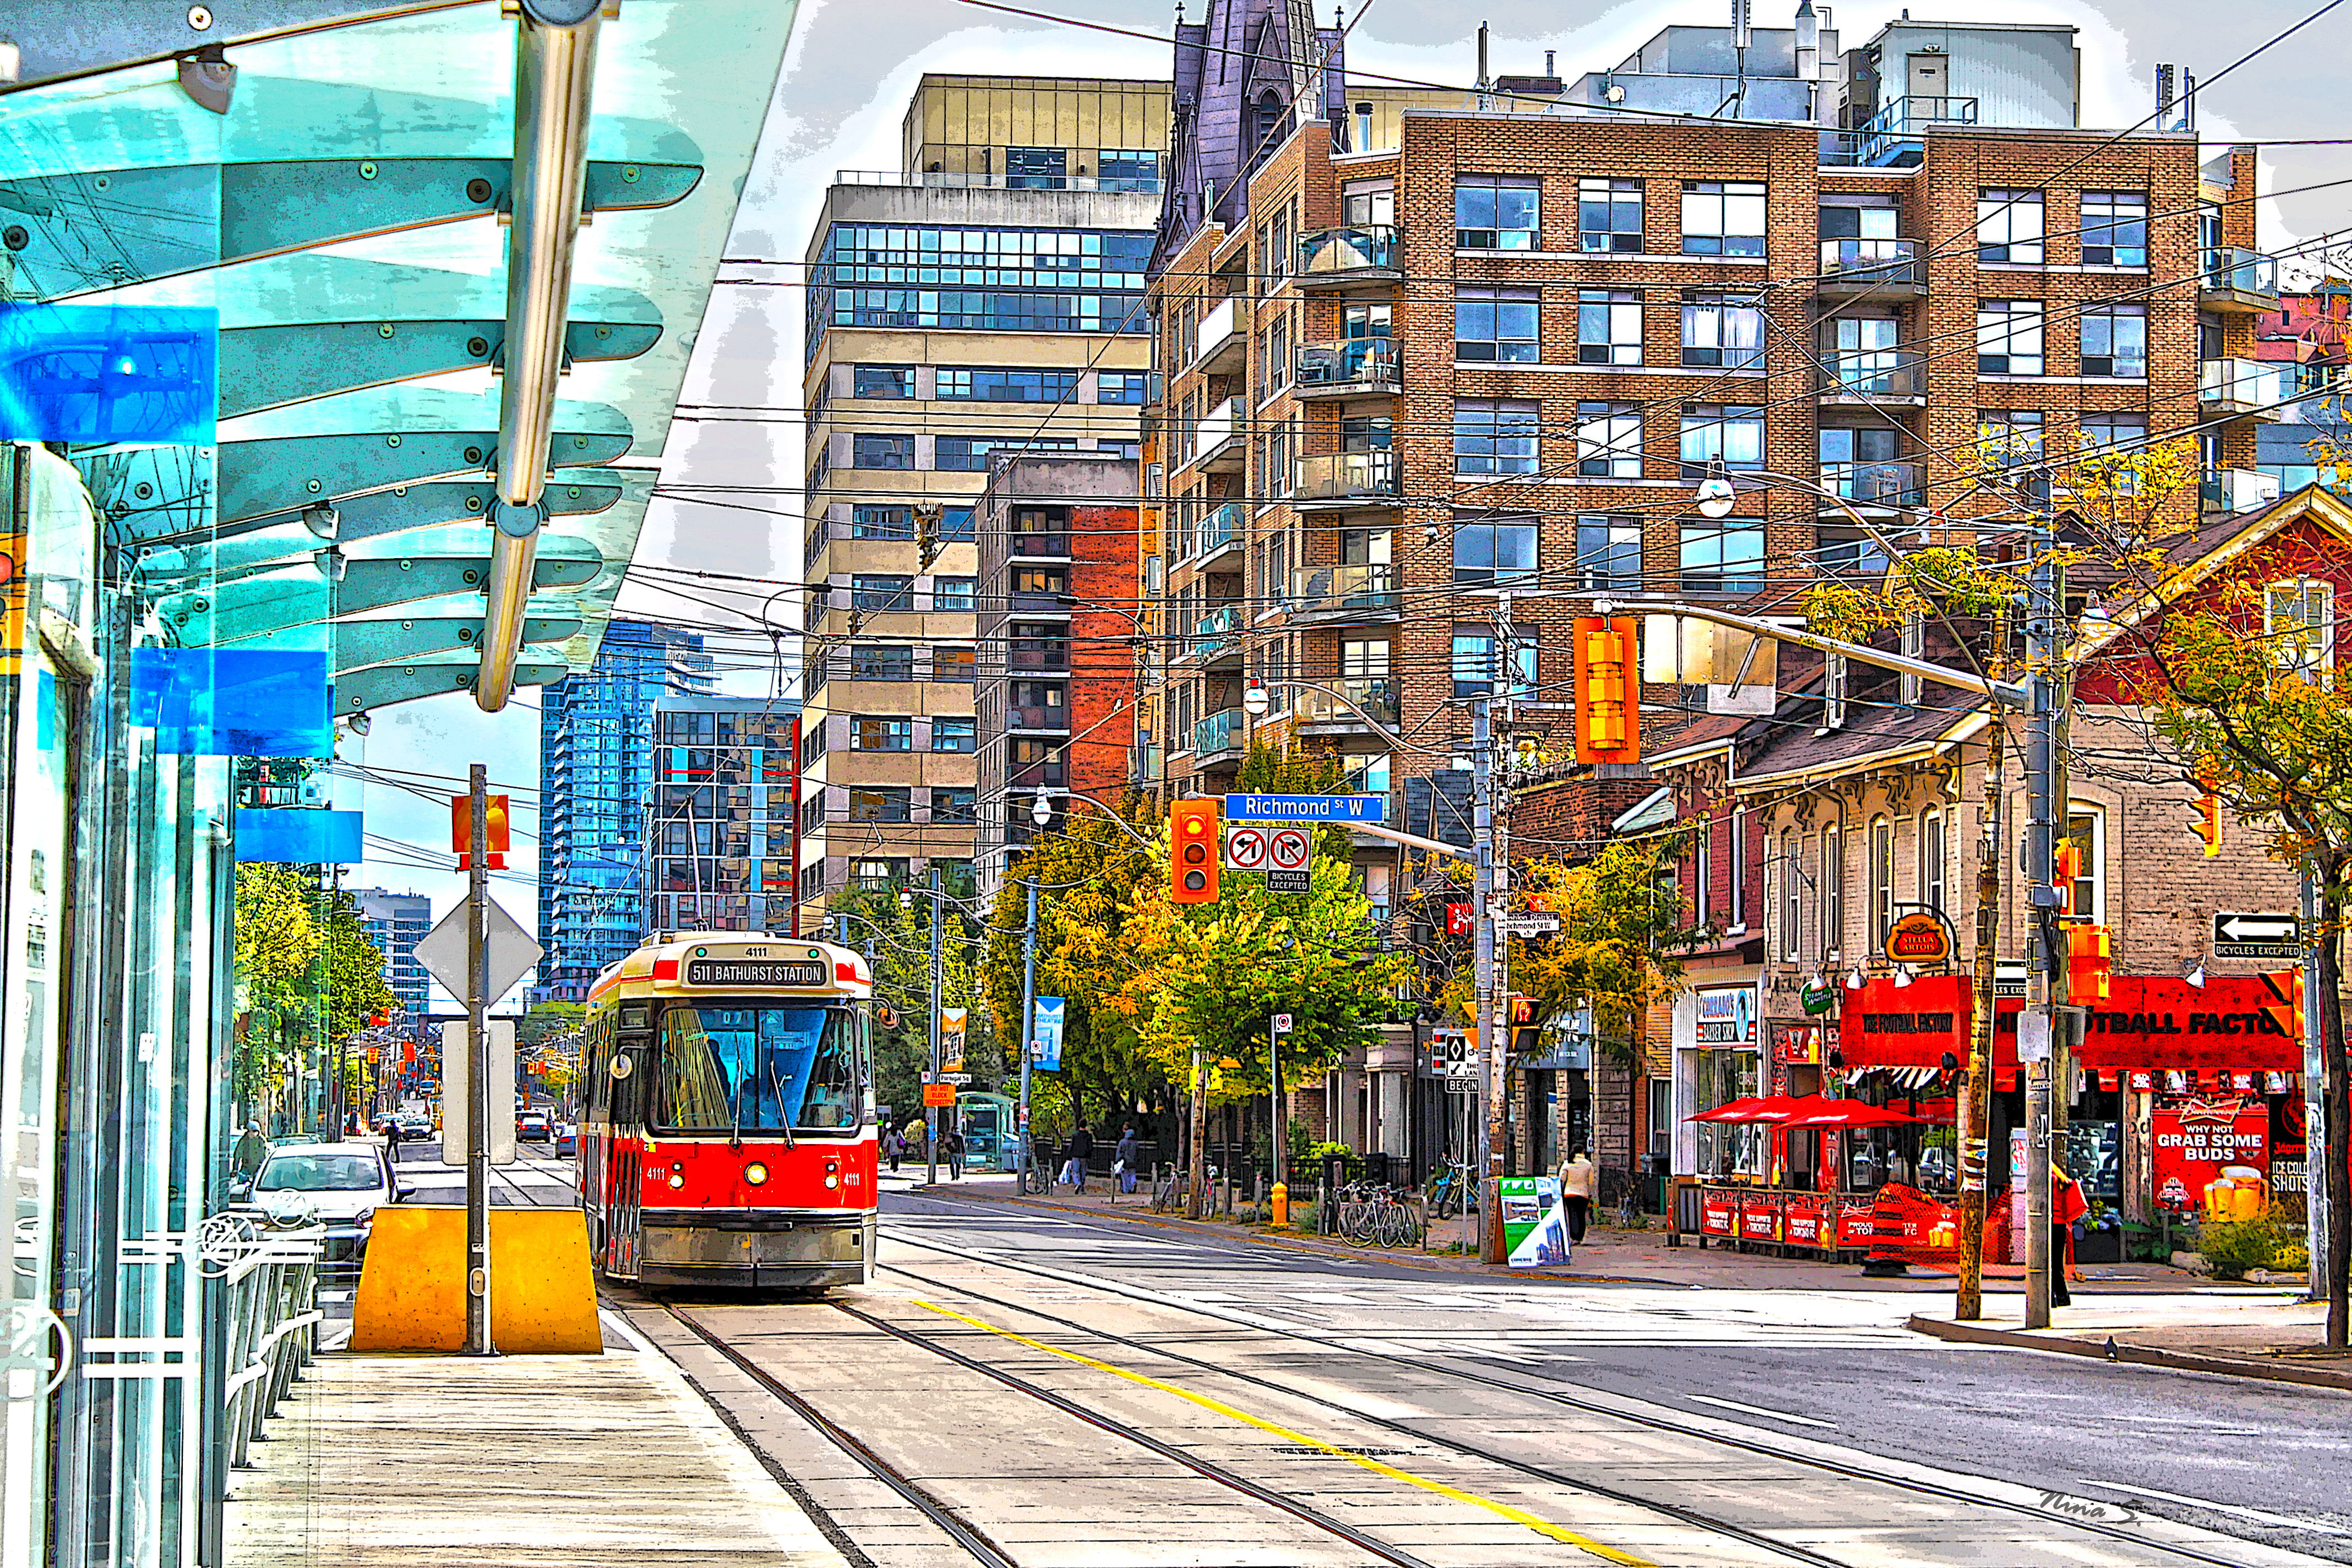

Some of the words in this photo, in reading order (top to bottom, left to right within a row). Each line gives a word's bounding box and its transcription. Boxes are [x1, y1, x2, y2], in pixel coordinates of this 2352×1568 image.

[1246, 798, 1330, 815] Richmond
[1335, 799, 1344, 809] St
[1349, 799, 1364, 816] W
[1271, 872, 1306, 881] BICYCLES
[1270, 881, 1308, 890] EXCEPTED
[745, 947, 767, 957] 4111
[2216, 946, 2255, 955] BICYCLES
[693, 965, 711, 981] 511
[715, 966, 772, 981] BATHURST
[775, 966, 821, 981] STATION
[1862, 1014, 1877, 1033] THE
[1878, 1014, 1917, 1033] FOOTBALL
[1918, 1012, 1953, 1032] FACTORY
[2189, 1012, 2275, 1034] FACTO
[2185, 1125, 2211, 1134] WHY
[2212, 1125, 2234, 1134] NOT
[2157, 1135, 2207, 1147] GRAB
[2211, 1134, 2263, 1147] SOME
[2185, 1148, 2235, 1161] BUDS
[647, 1167, 665, 1180] 4111
[2272, 1161, 2286, 1175] ICE
[843, 1173, 860, 1185] 4111
[1502, 1180, 1534, 1190] FWD
[2272, 1174, 2307, 1192] SHOTS
